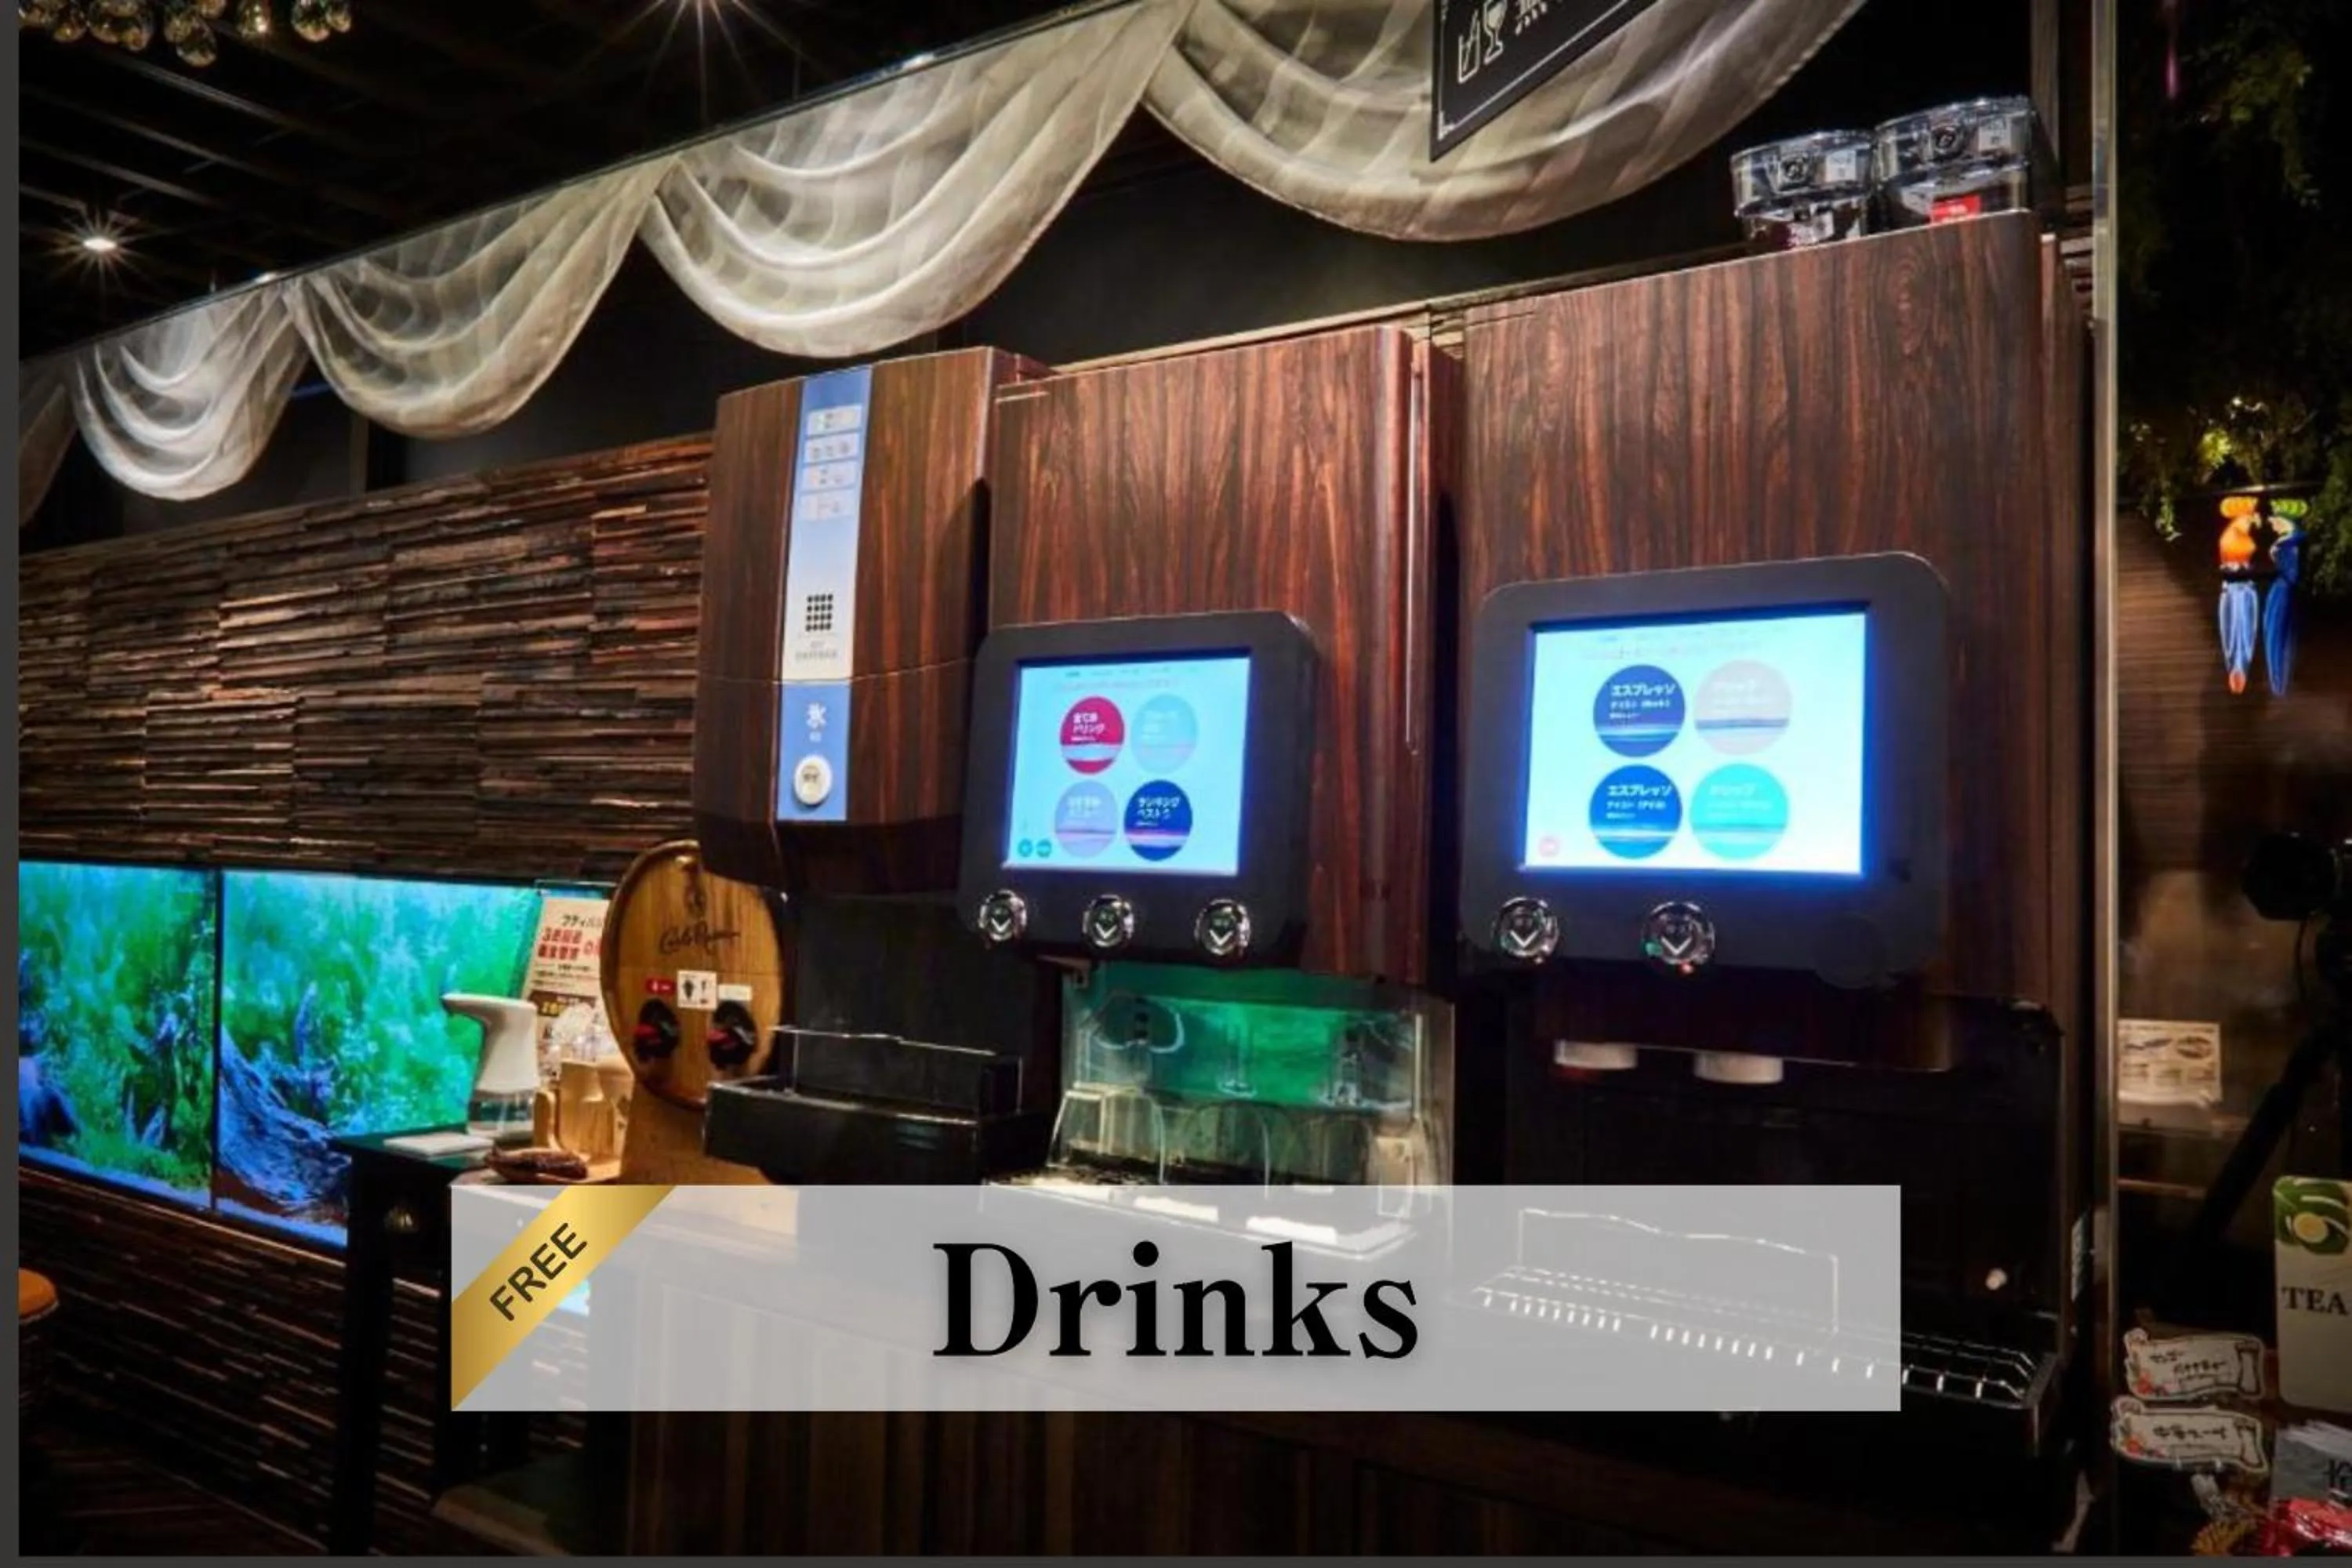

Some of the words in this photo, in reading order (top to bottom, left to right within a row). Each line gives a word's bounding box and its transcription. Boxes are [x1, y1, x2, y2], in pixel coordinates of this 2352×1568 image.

[1611, 683, 1675, 697] エスプレッソ
[1607, 784, 1671, 797] エスプレッソ
[2281, 1287, 2350, 1316] TEA
